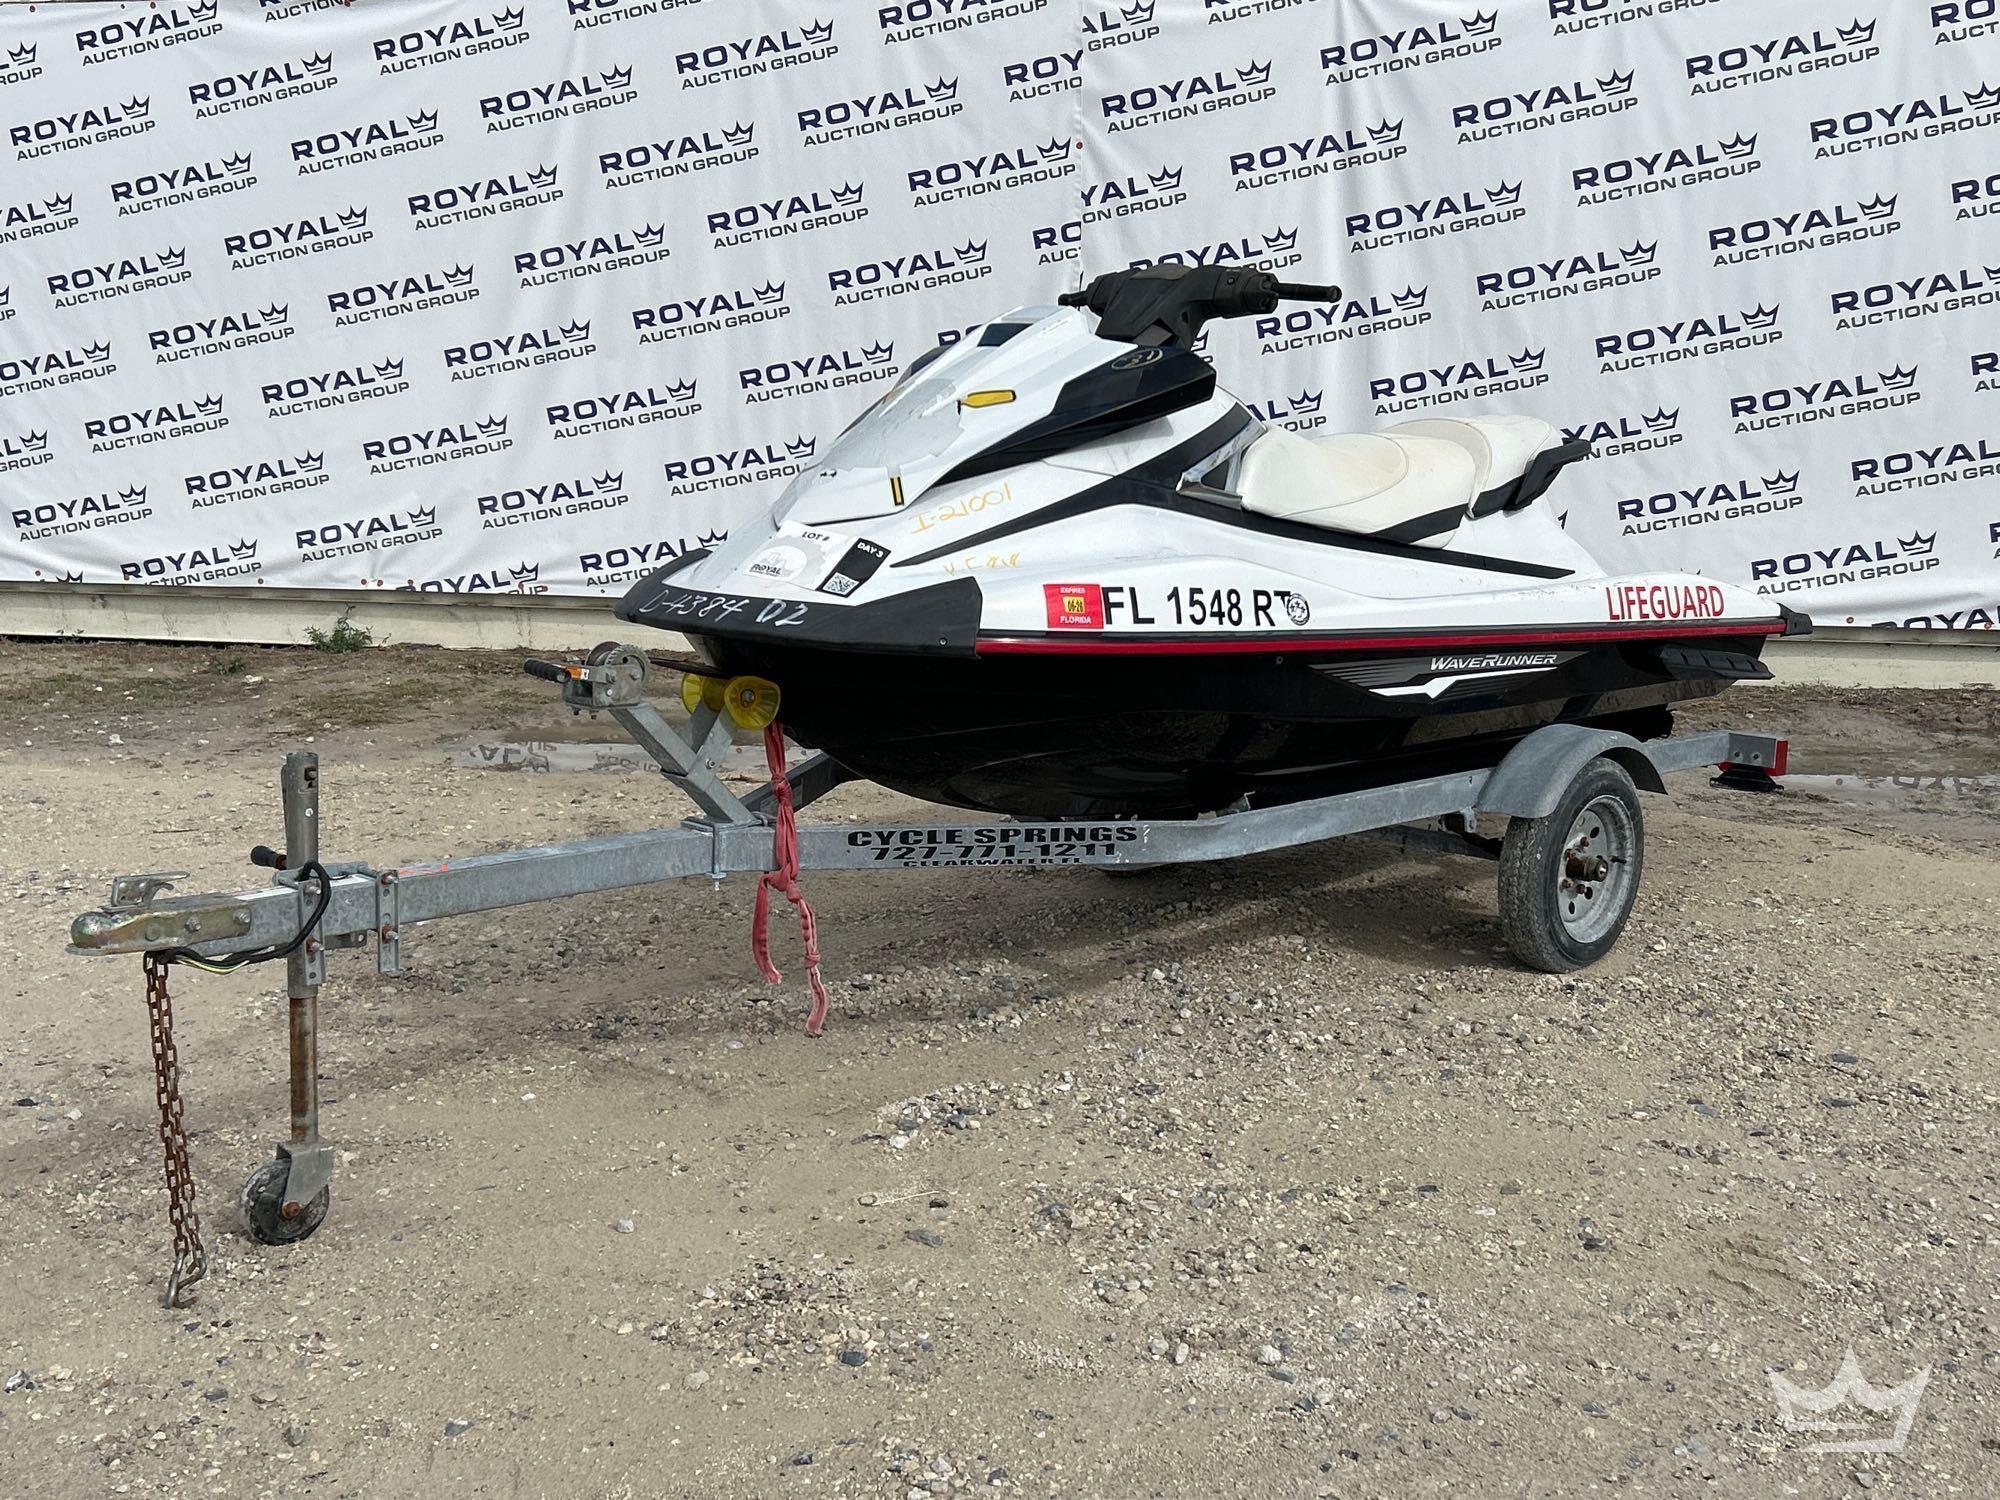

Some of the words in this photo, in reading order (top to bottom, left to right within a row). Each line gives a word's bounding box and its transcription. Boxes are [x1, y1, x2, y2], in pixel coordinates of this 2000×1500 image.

[76, 10, 190, 51] ROYAL
[83, 39, 159, 66] AUCTION
[163, 24, 222, 46] GROUP
[373, 18, 494, 60] ROYAL
[1320, 22, 1461, 69] ROYAL
[380, 48, 461, 75] AUCTION
[465, 32, 529, 56] GROUP
[675, 31, 801, 74] ROYAL
[682, 62, 767, 90] AUCTION
[771, 46, 838, 70] GROUP
[1326, 55, 1420, 86] AUCTION
[1425, 38, 1501, 63] GROUP
[1686, 31, 1836, 79] ROYAL
[1691, 65, 1792, 96] AUCTION
[1798, 47, 1879, 73] GROUP
[189, 63, 304, 104] ROYAL
[196, 92, 272, 119] AUCTION
[276, 77, 337, 100] GROUP
[480, 76, 602, 118] ROYAL
[1101, 72, 1236, 117] ROYAL
[487, 106, 569, 133] AUCTION
[573, 91, 637, 114] GROUP
[798, 88, 925, 131] ROYAL
[804, 119, 890, 147] AUCTION
[894, 103, 963, 127] GROUP
[1108, 104, 1198, 134] AUCTION
[1203, 87, 1276, 112] GROUP
[1453, 82, 1596, 128] ROYAL
[1458, 114, 1555, 144] AUCTION
[1560, 97, 1638, 122] GROUP
[10, 107, 122, 146] ROYAL
[17, 135, 92, 161] AUCTION
[95, 120, 155, 142] GROUP
[291, 120, 409, 161] ROYAL
[298, 149, 377, 176] AUCTION
[381, 134, 444, 157] GROUP
[599, 133, 723, 174] ROYAL
[606, 163, 689, 189] AUCTION
[693, 148, 759, 170] GROUP
[908, 149, 1038, 191] ROYAL
[1230, 130, 1367, 175] ROYAL
[1235, 162, 1328, 191] AUCTION
[1333, 146, 1407, 170] GROUP
[1572, 145, 1719, 190] ROYAL
[111, 162, 224, 202] ROYAL
[119, 191, 193, 217] AUCTION
[197, 177, 257, 198] GROUP
[914, 180, 1001, 207] AUCTION
[1006, 164, 1075, 188] GROUP
[1577, 177, 1676, 207] AUCTION
[1682, 161, 1761, 185] GROUP
[707, 193, 832, 233] ROYAL
[714, 222, 797, 249] AUCTION
[801, 208, 868, 230] GROUP
[1346, 192, 1485, 237] ROYAL
[1351, 224, 1445, 253] AUCTION
[1450, 208, 1525, 232] GROUP
[1709, 205, 1858, 250] ROYAL
[224, 217, 339, 256] ROYAL
[232, 245, 308, 270] AUCTION
[312, 231, 373, 252] GROUP
[514, 234, 635, 273] ROYAL
[1713, 238, 1814, 267] AUCTION
[1820, 222, 1900, 246] GROUP
[47, 257, 159, 294] ROYAL
[521, 263, 601, 288] AUCTION
[605, 249, 670, 270] GROUP
[828, 251, 955, 291] ROYAL
[835, 280, 919, 306] AUCTION
[924, 266, 991, 288] GROUP
[1477, 252, 1620, 295] ROYAL
[55, 284, 129, 309] AUCTION
[133, 271, 191, 292] GROUP
[328, 274, 444, 312] ROYAL
[336, 302, 413, 327] AUCTION
[417, 289, 479, 310] GROUP
[632, 291, 754, 329] ROYAL
[1482, 283, 1578, 312] AUCTION
[1583, 268, 1661, 292] GROUP
[148, 313, 261, 350] ROYAL
[639, 320, 721, 345] AUCTION
[725, 306, 790, 327] GROUP
[1256, 297, 1392, 339] ROYAL
[1262, 327, 1353, 355] AUCTION
[1358, 312, 1431, 335] GROUP
[1595, 315, 1740, 358] ROYAL
[156, 340, 231, 364] AUCTION
[234, 327, 294, 347] GROUP
[444, 329, 561, 367] ROYAL
[452, 358, 530, 382] AUCTION
[534, 344, 596, 365] GROUP
[1600, 346, 1698, 374] AUCTION
[1704, 331, 1782, 354] GROUP
[739, 351, 862, 389] ROYAL
[746, 380, 828, 404] AUCTION
[832, 367, 898, 387] GROUP
[1370, 358, 1509, 400] ROYAL
[546, 388, 667, 425] ROYAL
[1375, 389, 1468, 416] AUCTION
[1474, 374, 1548, 397] GROUP
[1730, 375, 1878, 417] ROYAL
[1735, 407, 1834, 434] AUCTION
[1840, 392, 1920, 415] GROUP
[85, 403, 196, 439] ROYAL
[93, 430, 166, 453] AUCTION
[170, 418, 229, 437] GROUP
[554, 416, 634, 439] AUCTION
[638, 404, 702, 424] GROUP
[363, 425, 477, 460] ROYAL
[370, 452, 447, 475] AUCTION
[450, 439, 513, 459] GROUP
[185, 460, 296, 495] ROYAL
[192, 486, 266, 509] AUCTION
[270, 475, 329, 493] GROUP
[478, 480, 594, 515] ROYAL
[12, 494, 120, 528] ROYAL
[483, 507, 562, 529] AUCTION
[566, 495, 628, 514] GROUP
[1618, 480, 1761, 520] ROYAL
[1622, 510, 1719, 536] AUCTION
[1725, 497, 1802, 518] GROUP
[20, 520, 91, 542] AUCTION
[94, 509, 152, 527] GROUP
[296, 514, 408, 549] ROYAL
[302, 540, 377, 562] AUCTION
[382, 528, 442, 547] GROUP
[801, 531, 822, 541] LOT
[857, 542, 877, 554] DAY
[1751, 541, 1897, 580] ROYAL
[750, 563, 782, 575] ROYAL
[1757, 571, 1855, 595] AUCTION
[1860, 558, 1939, 579] GROUP
[1060, 615, 1092, 624] FLORIDA
[1101, 587, 1155, 625] FL
[1166, 587, 1243, 627] 1548
[1606, 586, 1724, 620] LIFEGUARD
[848, 829, 963, 847] CYCLE
[974, 826, 1137, 844] SPRINGS
[871, 843, 1116, 861] 727-771-1211
[903, 858, 1054, 867] CLEARWATER
